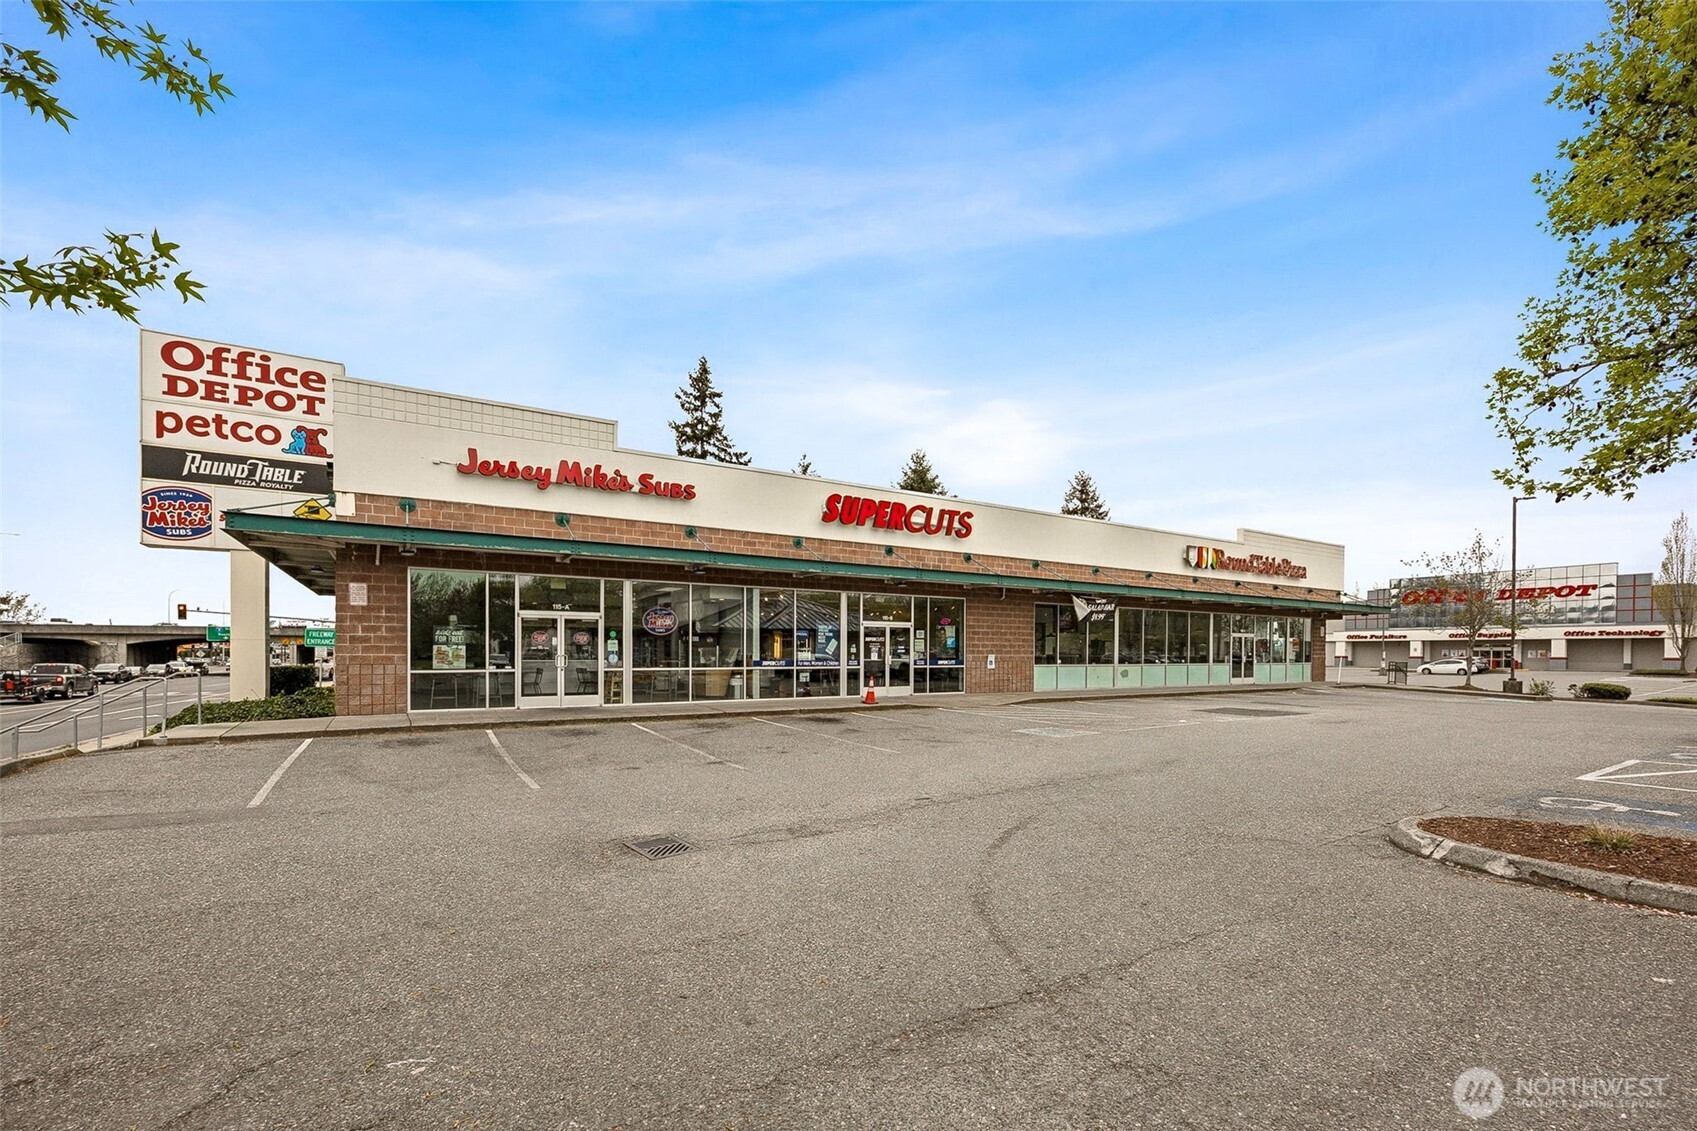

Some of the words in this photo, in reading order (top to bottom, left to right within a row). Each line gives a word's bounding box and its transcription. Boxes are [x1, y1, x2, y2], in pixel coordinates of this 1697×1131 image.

[160, 340, 326, 392] Office
[162, 373, 326, 416] DEPOT
[156, 410, 282, 445] petco
[456, 448, 551, 490] Jersey
[556, 460, 634, 491] Mike's
[234, 479, 257, 487] PIZZA
[259, 481, 294, 490] ROYALTY
[141, 496, 211, 516] Jersey
[821, 493, 974, 539] SUPERCUTS
[147, 511, 211, 527] Mike's
[166, 528, 193, 536] SUBS
[1494, 584, 1599, 600] DEPOT
[1598, 629, 1665, 637] Technology
